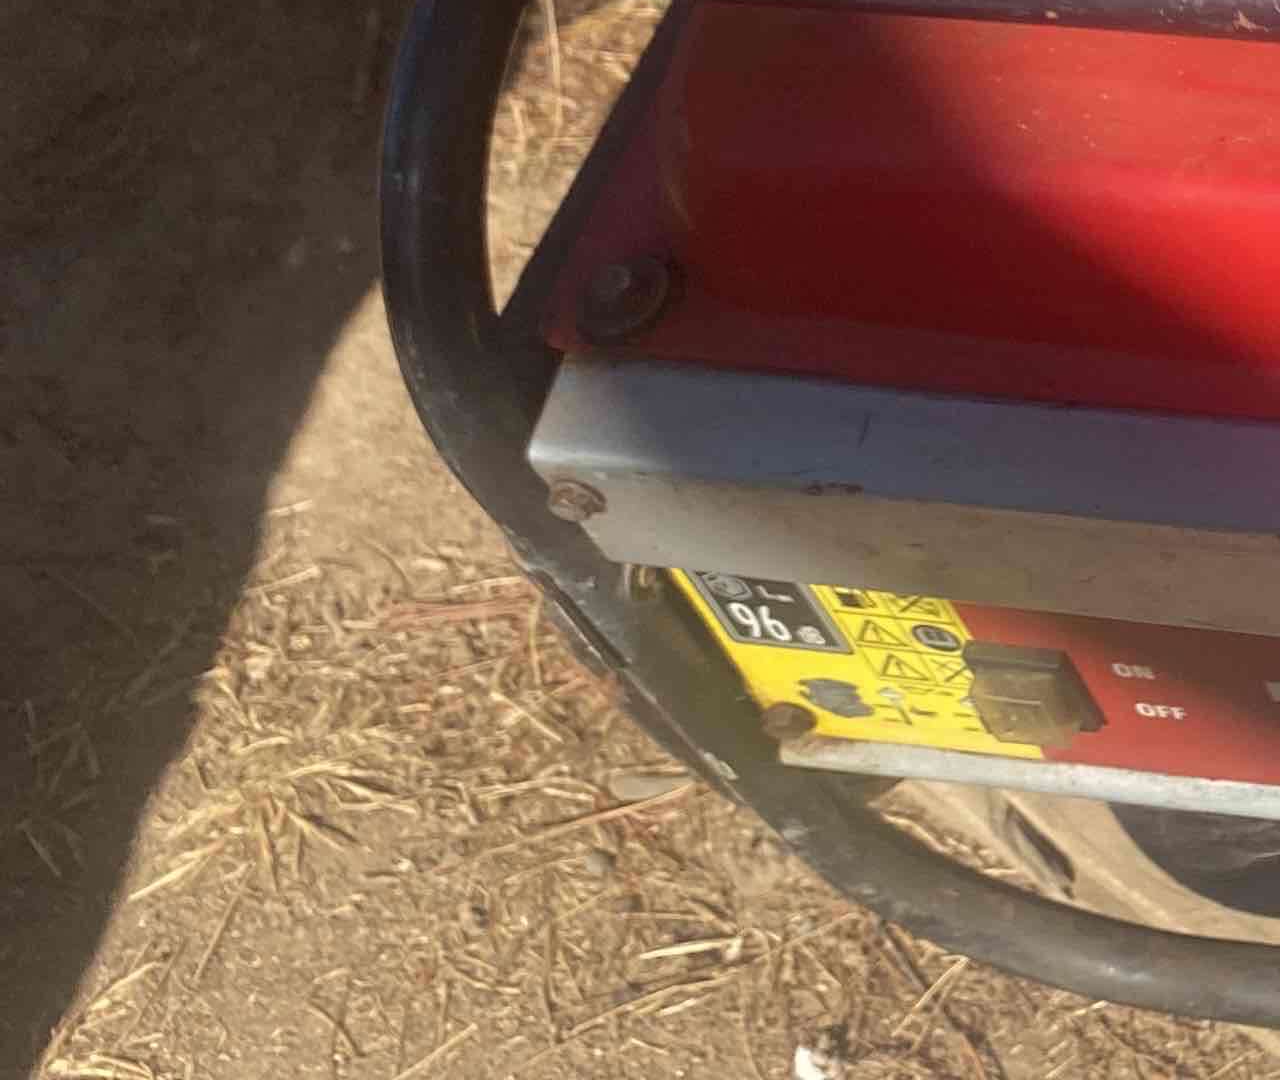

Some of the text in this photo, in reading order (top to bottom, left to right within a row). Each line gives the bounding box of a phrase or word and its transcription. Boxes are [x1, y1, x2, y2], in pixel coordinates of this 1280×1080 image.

[727, 601, 793, 642] 96
[1111, 662, 1156, 680] ON
[1134, 703, 1187, 721] OFF
